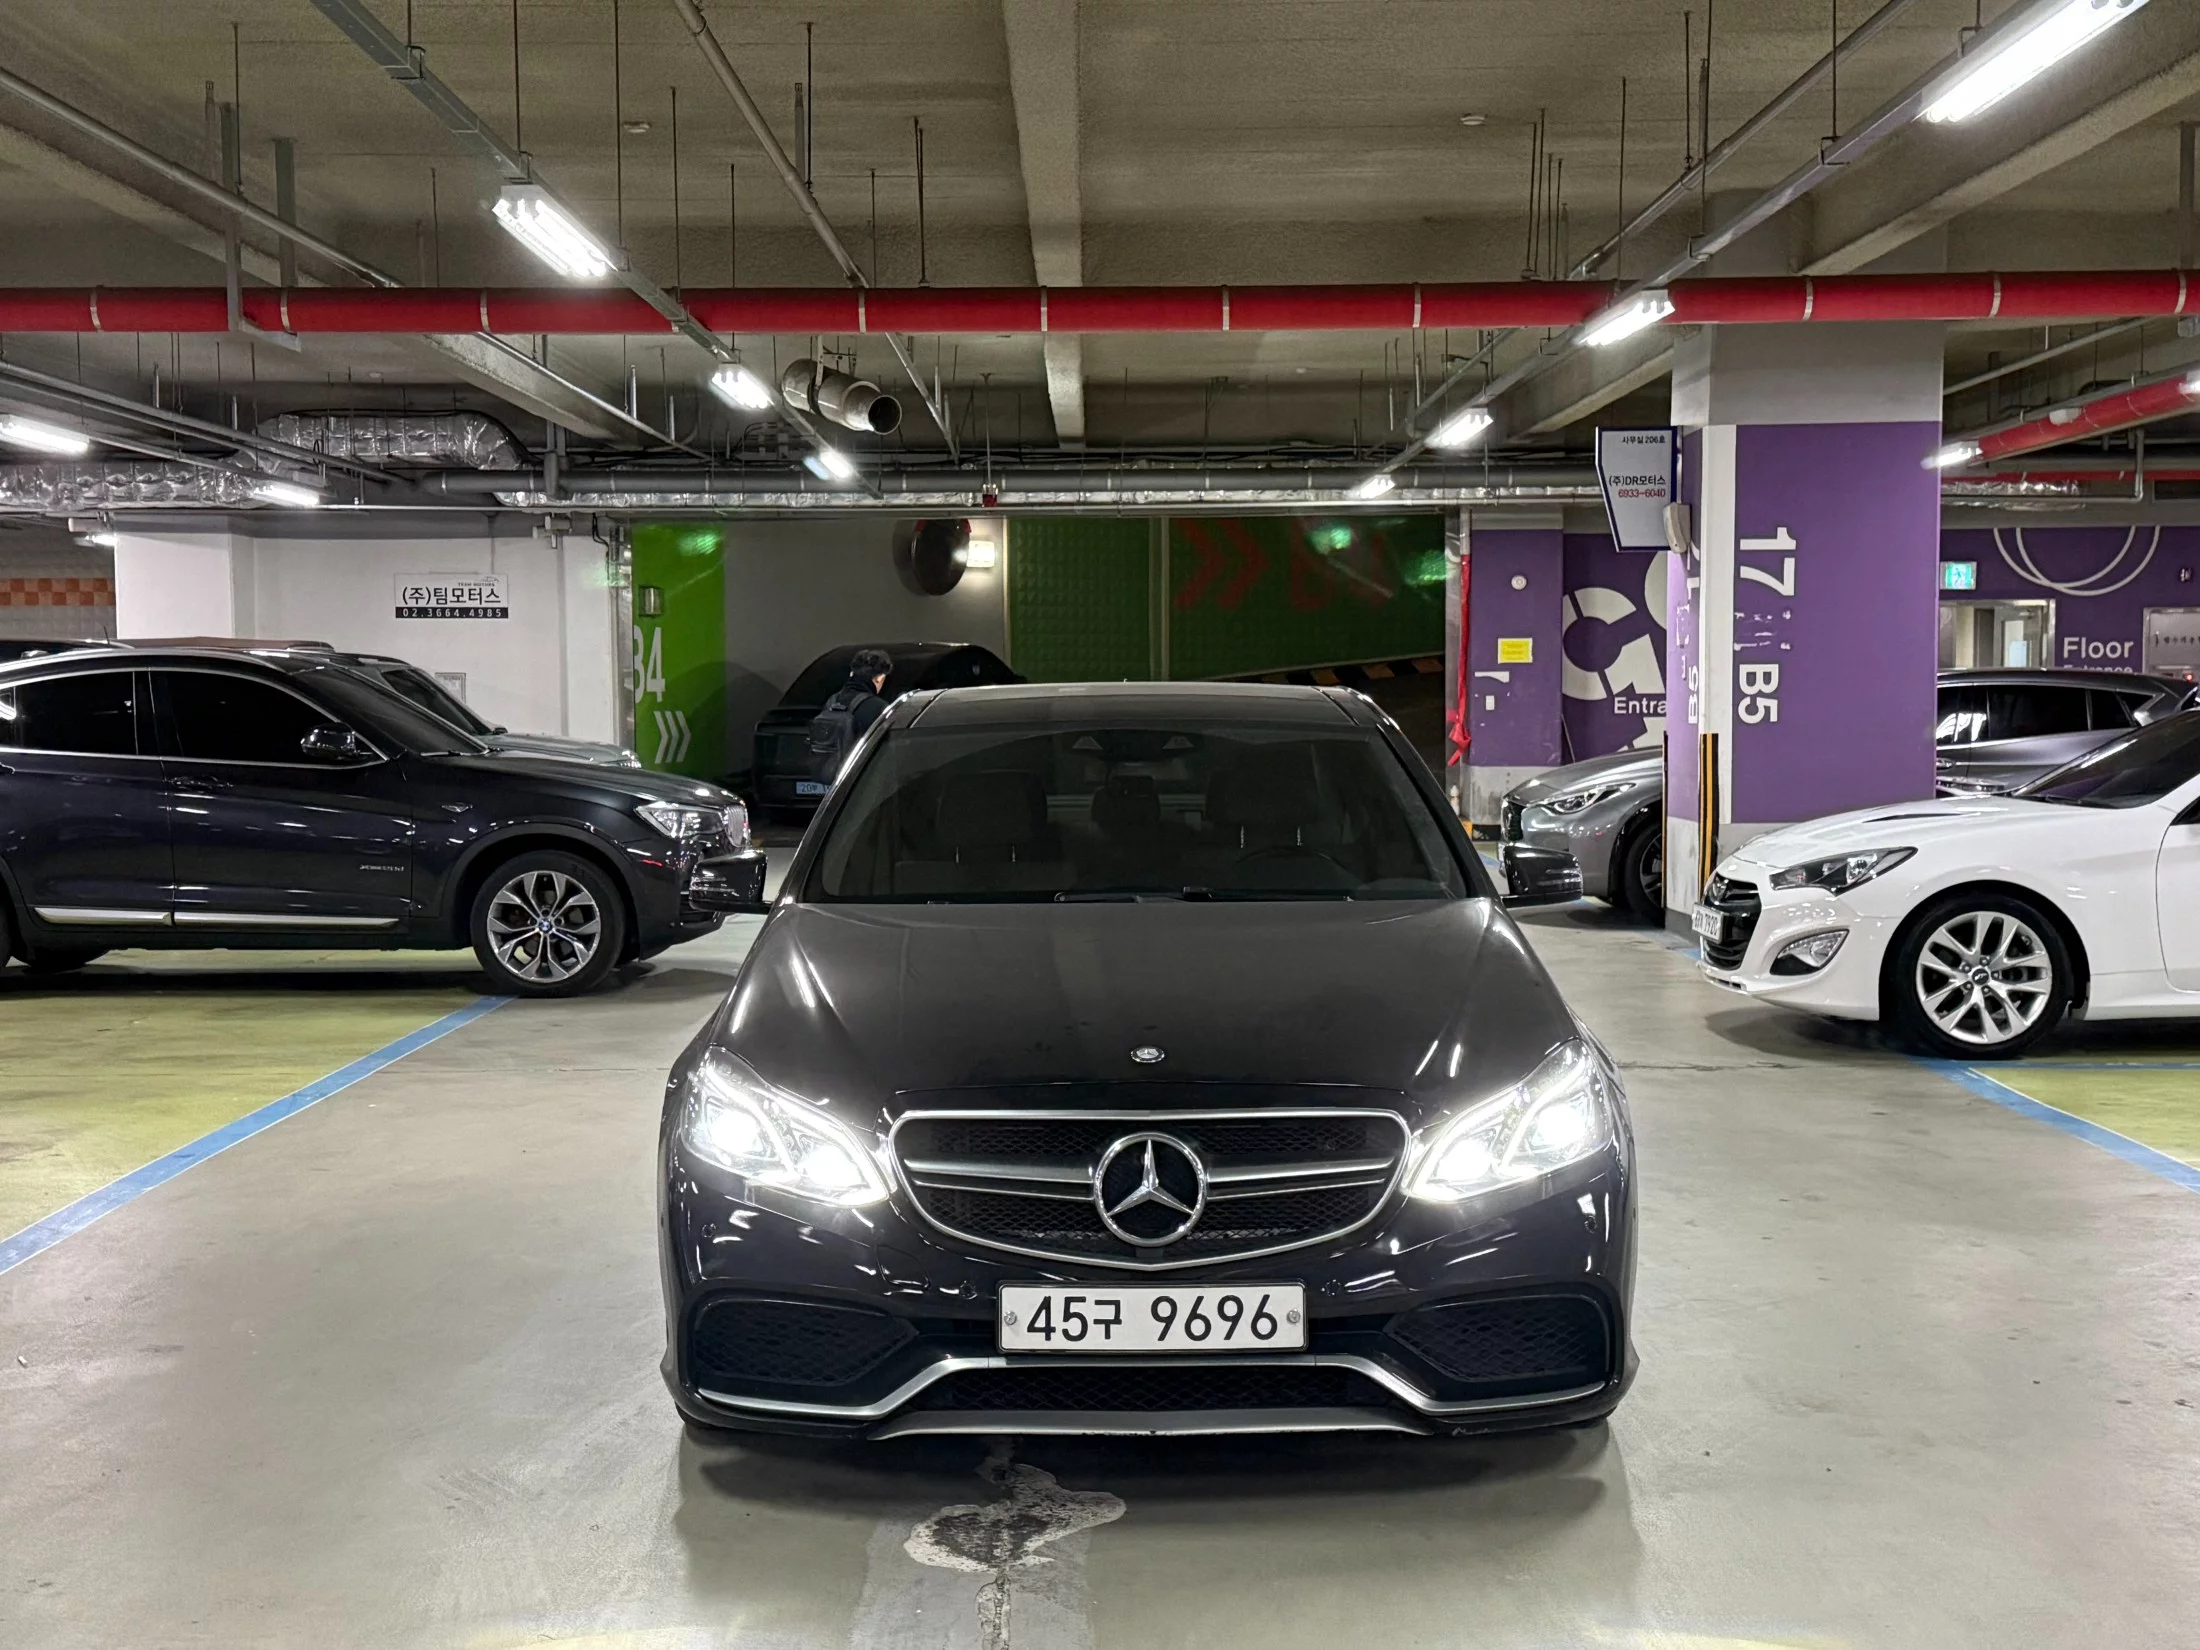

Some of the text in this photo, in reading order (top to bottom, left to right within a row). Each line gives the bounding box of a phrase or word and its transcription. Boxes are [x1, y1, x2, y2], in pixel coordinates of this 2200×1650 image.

[1618, 488, 1666, 498] 6933-6040
[402, 586, 502, 605] (주)팀모터스
[402, 608, 502, 617] 02.3664.4985
[1738, 527, 1797, 724] 17 B5
[2063, 636, 2134, 659] Floor
[1026, 1294, 1278, 1342] 45구 9696
